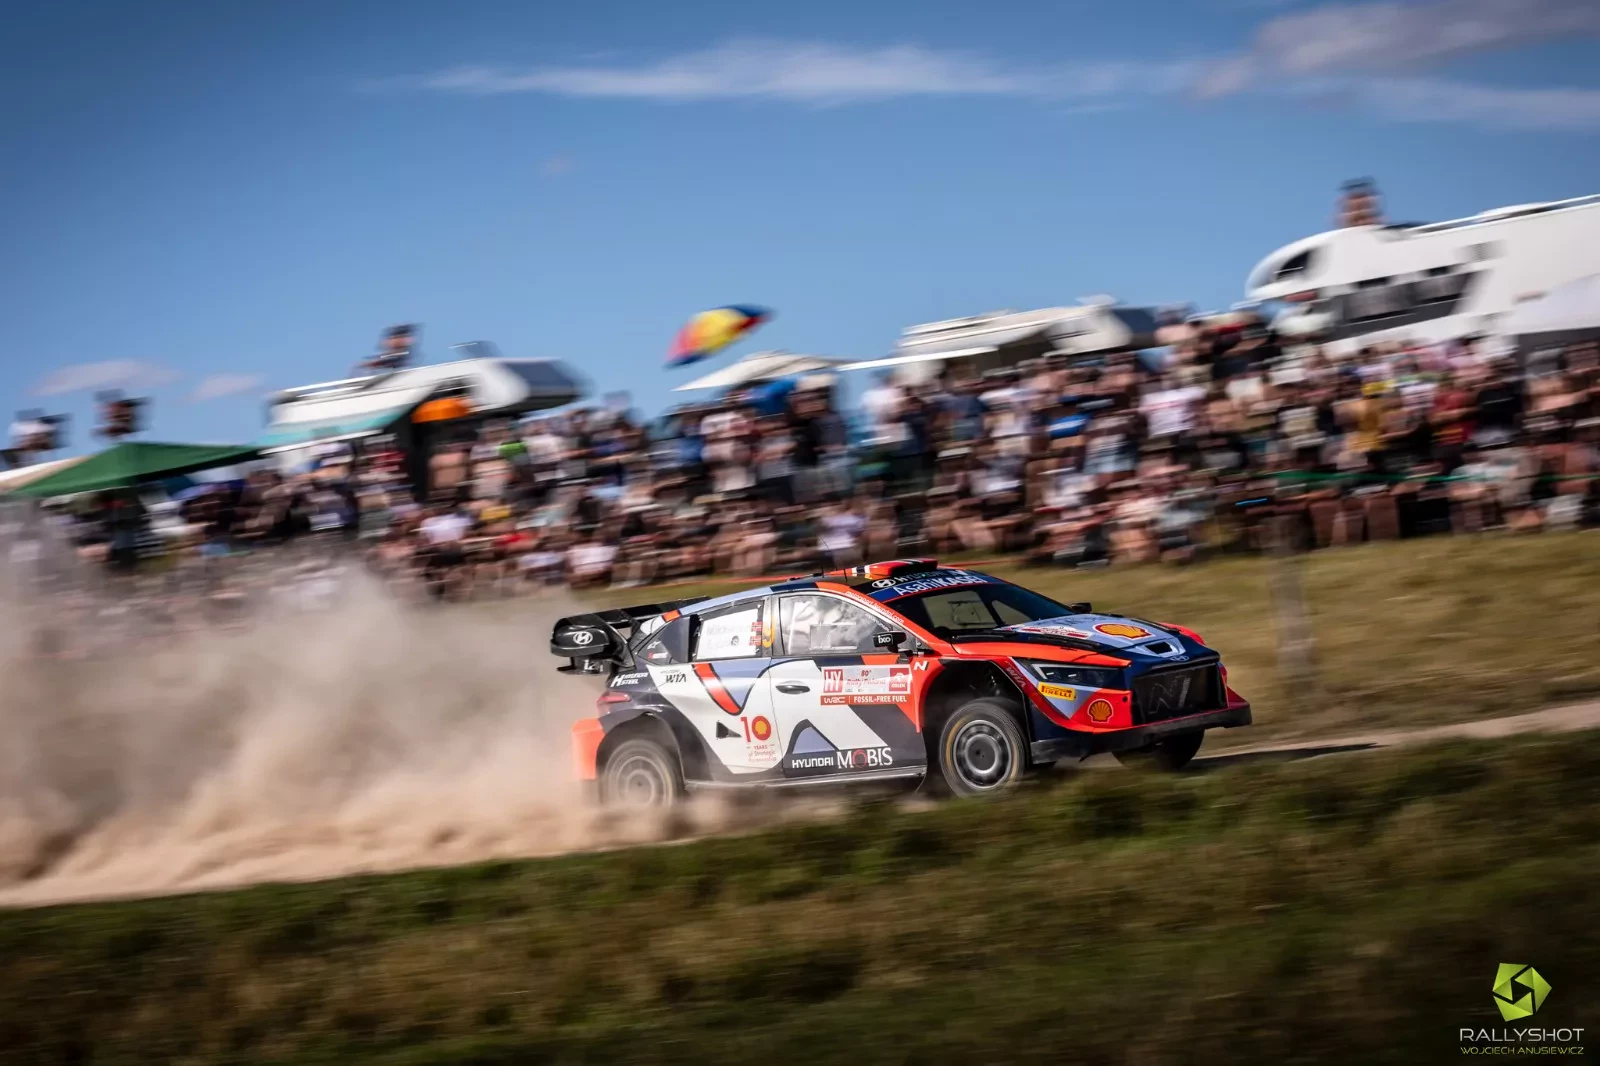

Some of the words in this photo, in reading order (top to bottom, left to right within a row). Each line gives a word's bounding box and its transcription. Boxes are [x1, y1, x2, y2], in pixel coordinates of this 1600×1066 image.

[878, 635, 891, 644] ixo
[1041, 685, 1072, 698] PIRELLI
[792, 757, 834, 769] HYUNDAI
[836, 747, 893, 769] MOBIS
